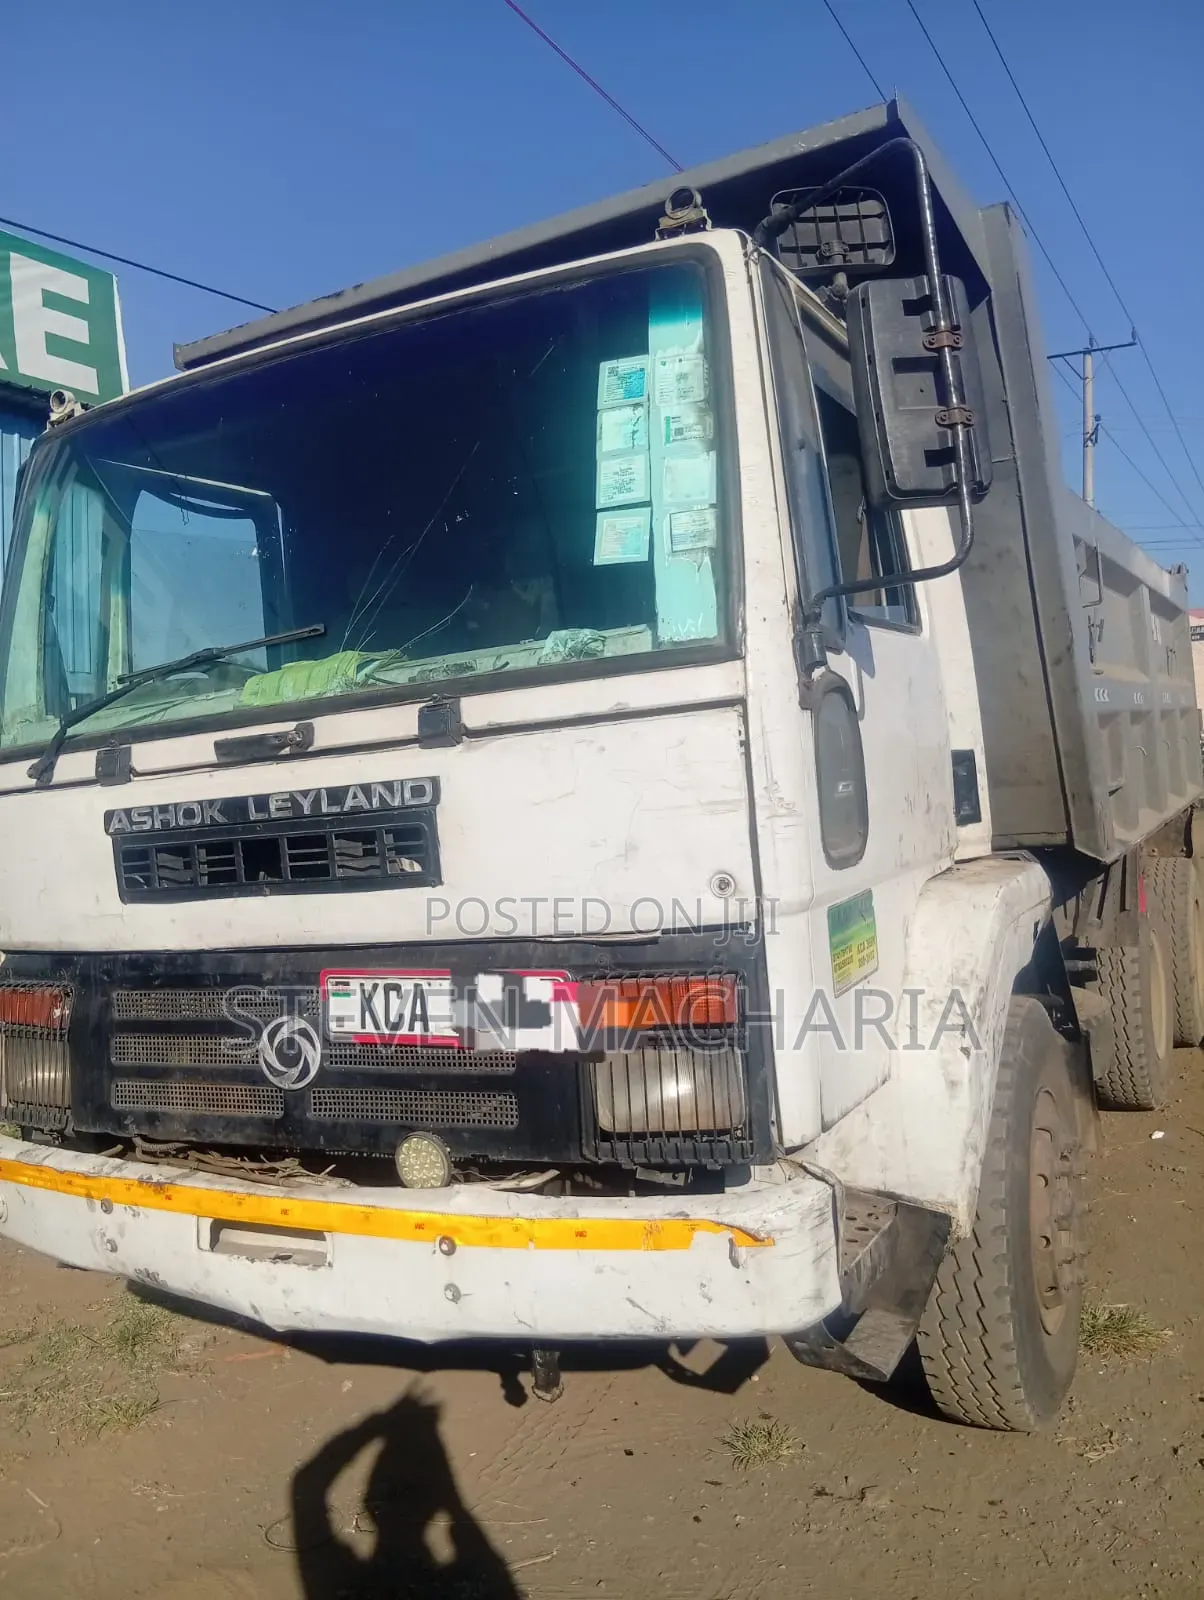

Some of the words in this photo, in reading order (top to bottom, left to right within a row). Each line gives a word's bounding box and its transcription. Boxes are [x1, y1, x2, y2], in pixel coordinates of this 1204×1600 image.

[108, 801, 228, 834] ASHOK
[248, 777, 434, 820] LEYLAND
[359, 982, 430, 1032] KCA
